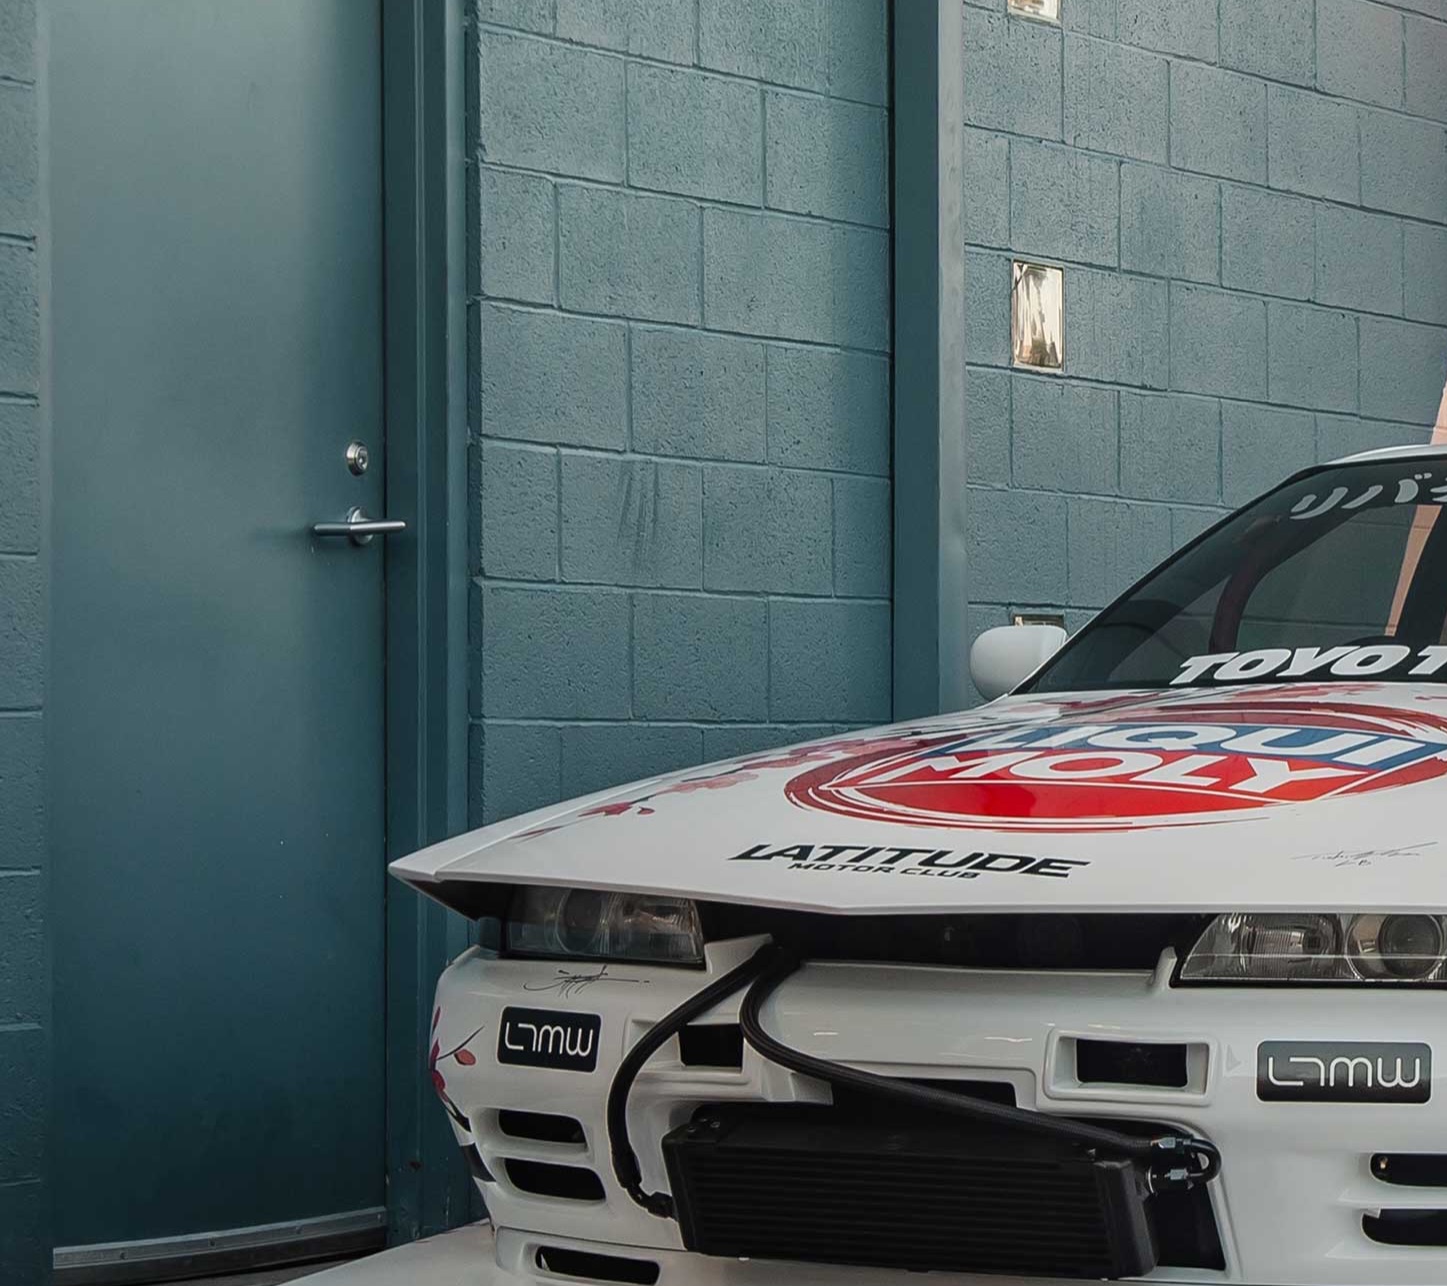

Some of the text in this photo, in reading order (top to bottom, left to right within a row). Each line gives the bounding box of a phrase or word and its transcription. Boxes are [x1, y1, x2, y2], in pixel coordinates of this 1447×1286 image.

[1169, 644, 1410, 686] TOYO
[944, 724, 1427, 767] LIQUI
[857, 749, 1369, 795] MOLY
[726, 843, 1092, 879] LATITUDE
[788, 861, 982, 880] MOTOR CLUB
